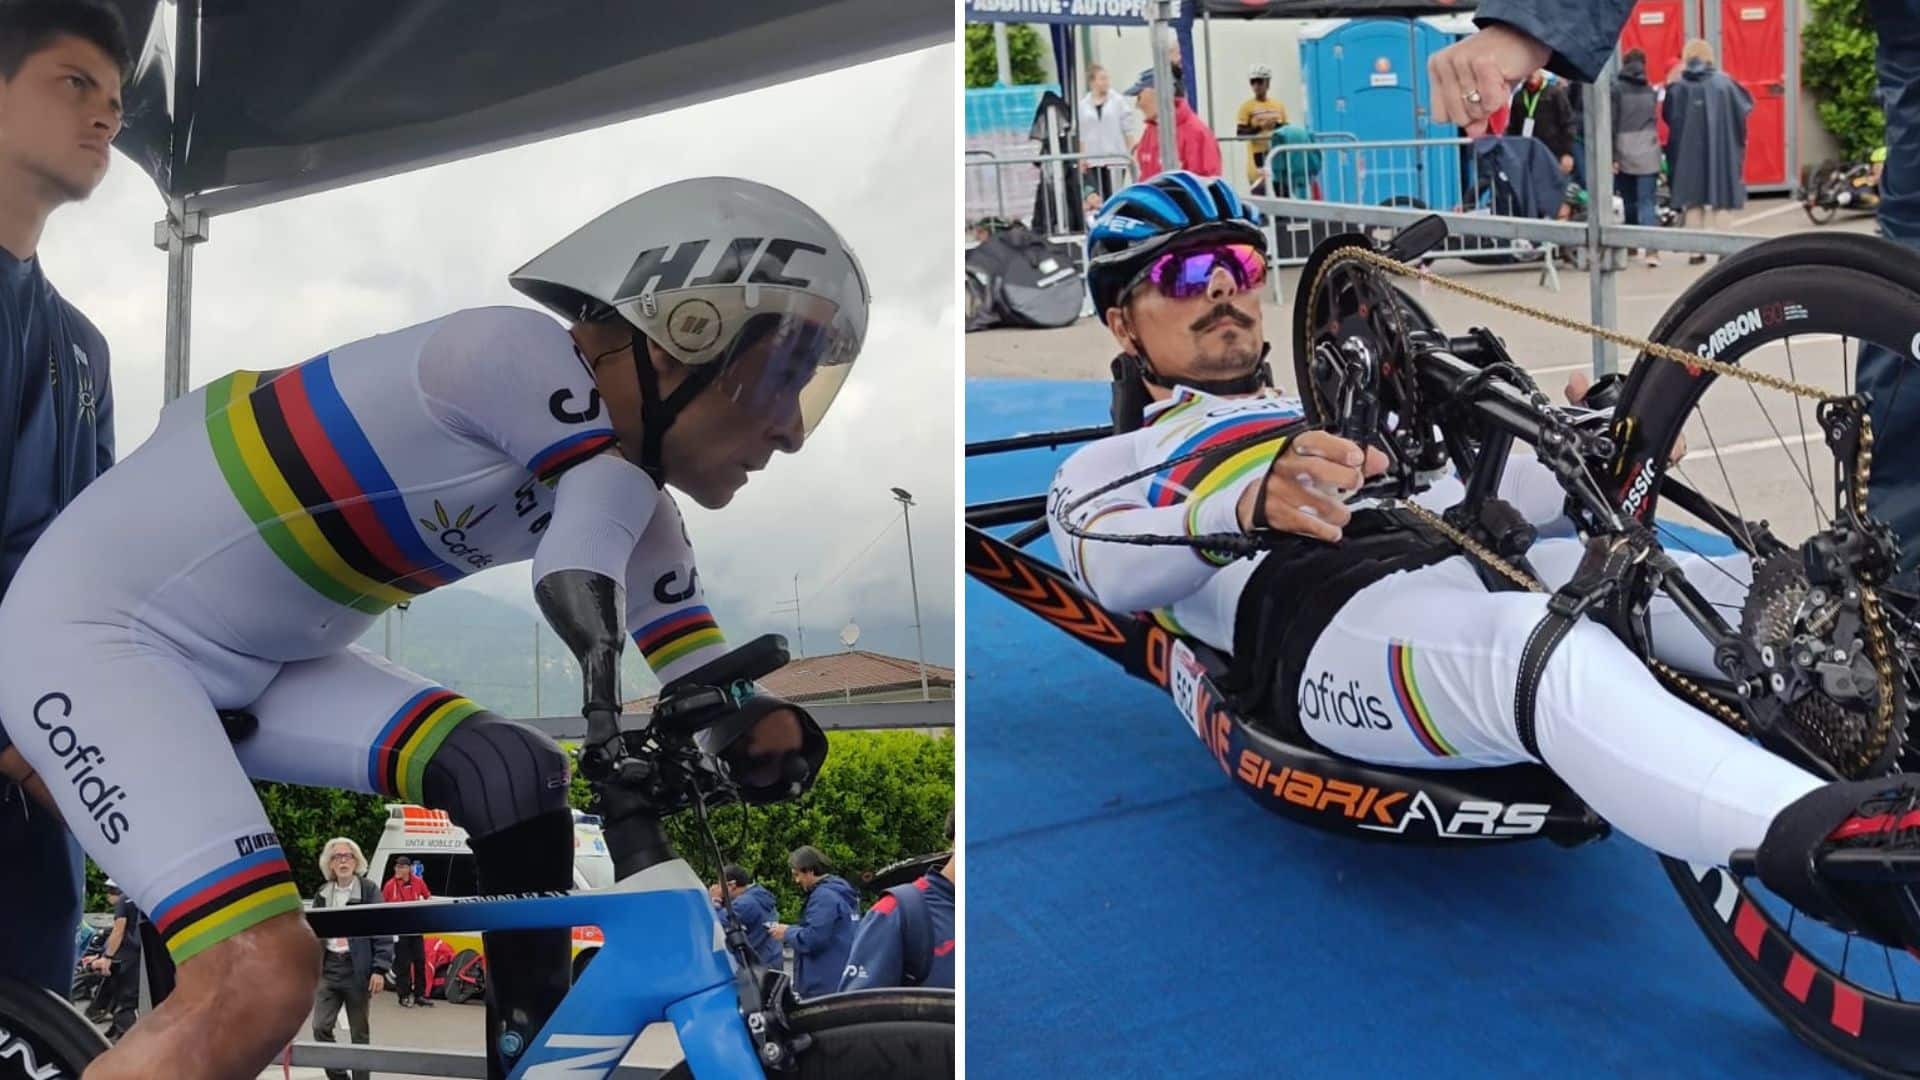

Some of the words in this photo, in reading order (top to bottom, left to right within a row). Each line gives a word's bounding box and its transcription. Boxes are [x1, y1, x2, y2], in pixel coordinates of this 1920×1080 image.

[612, 237, 826, 301] HJC
[1697, 308, 1763, 360] CARBON
[33, 692, 129, 845] Cofidis
[1237, 750, 1408, 824] SHARK
